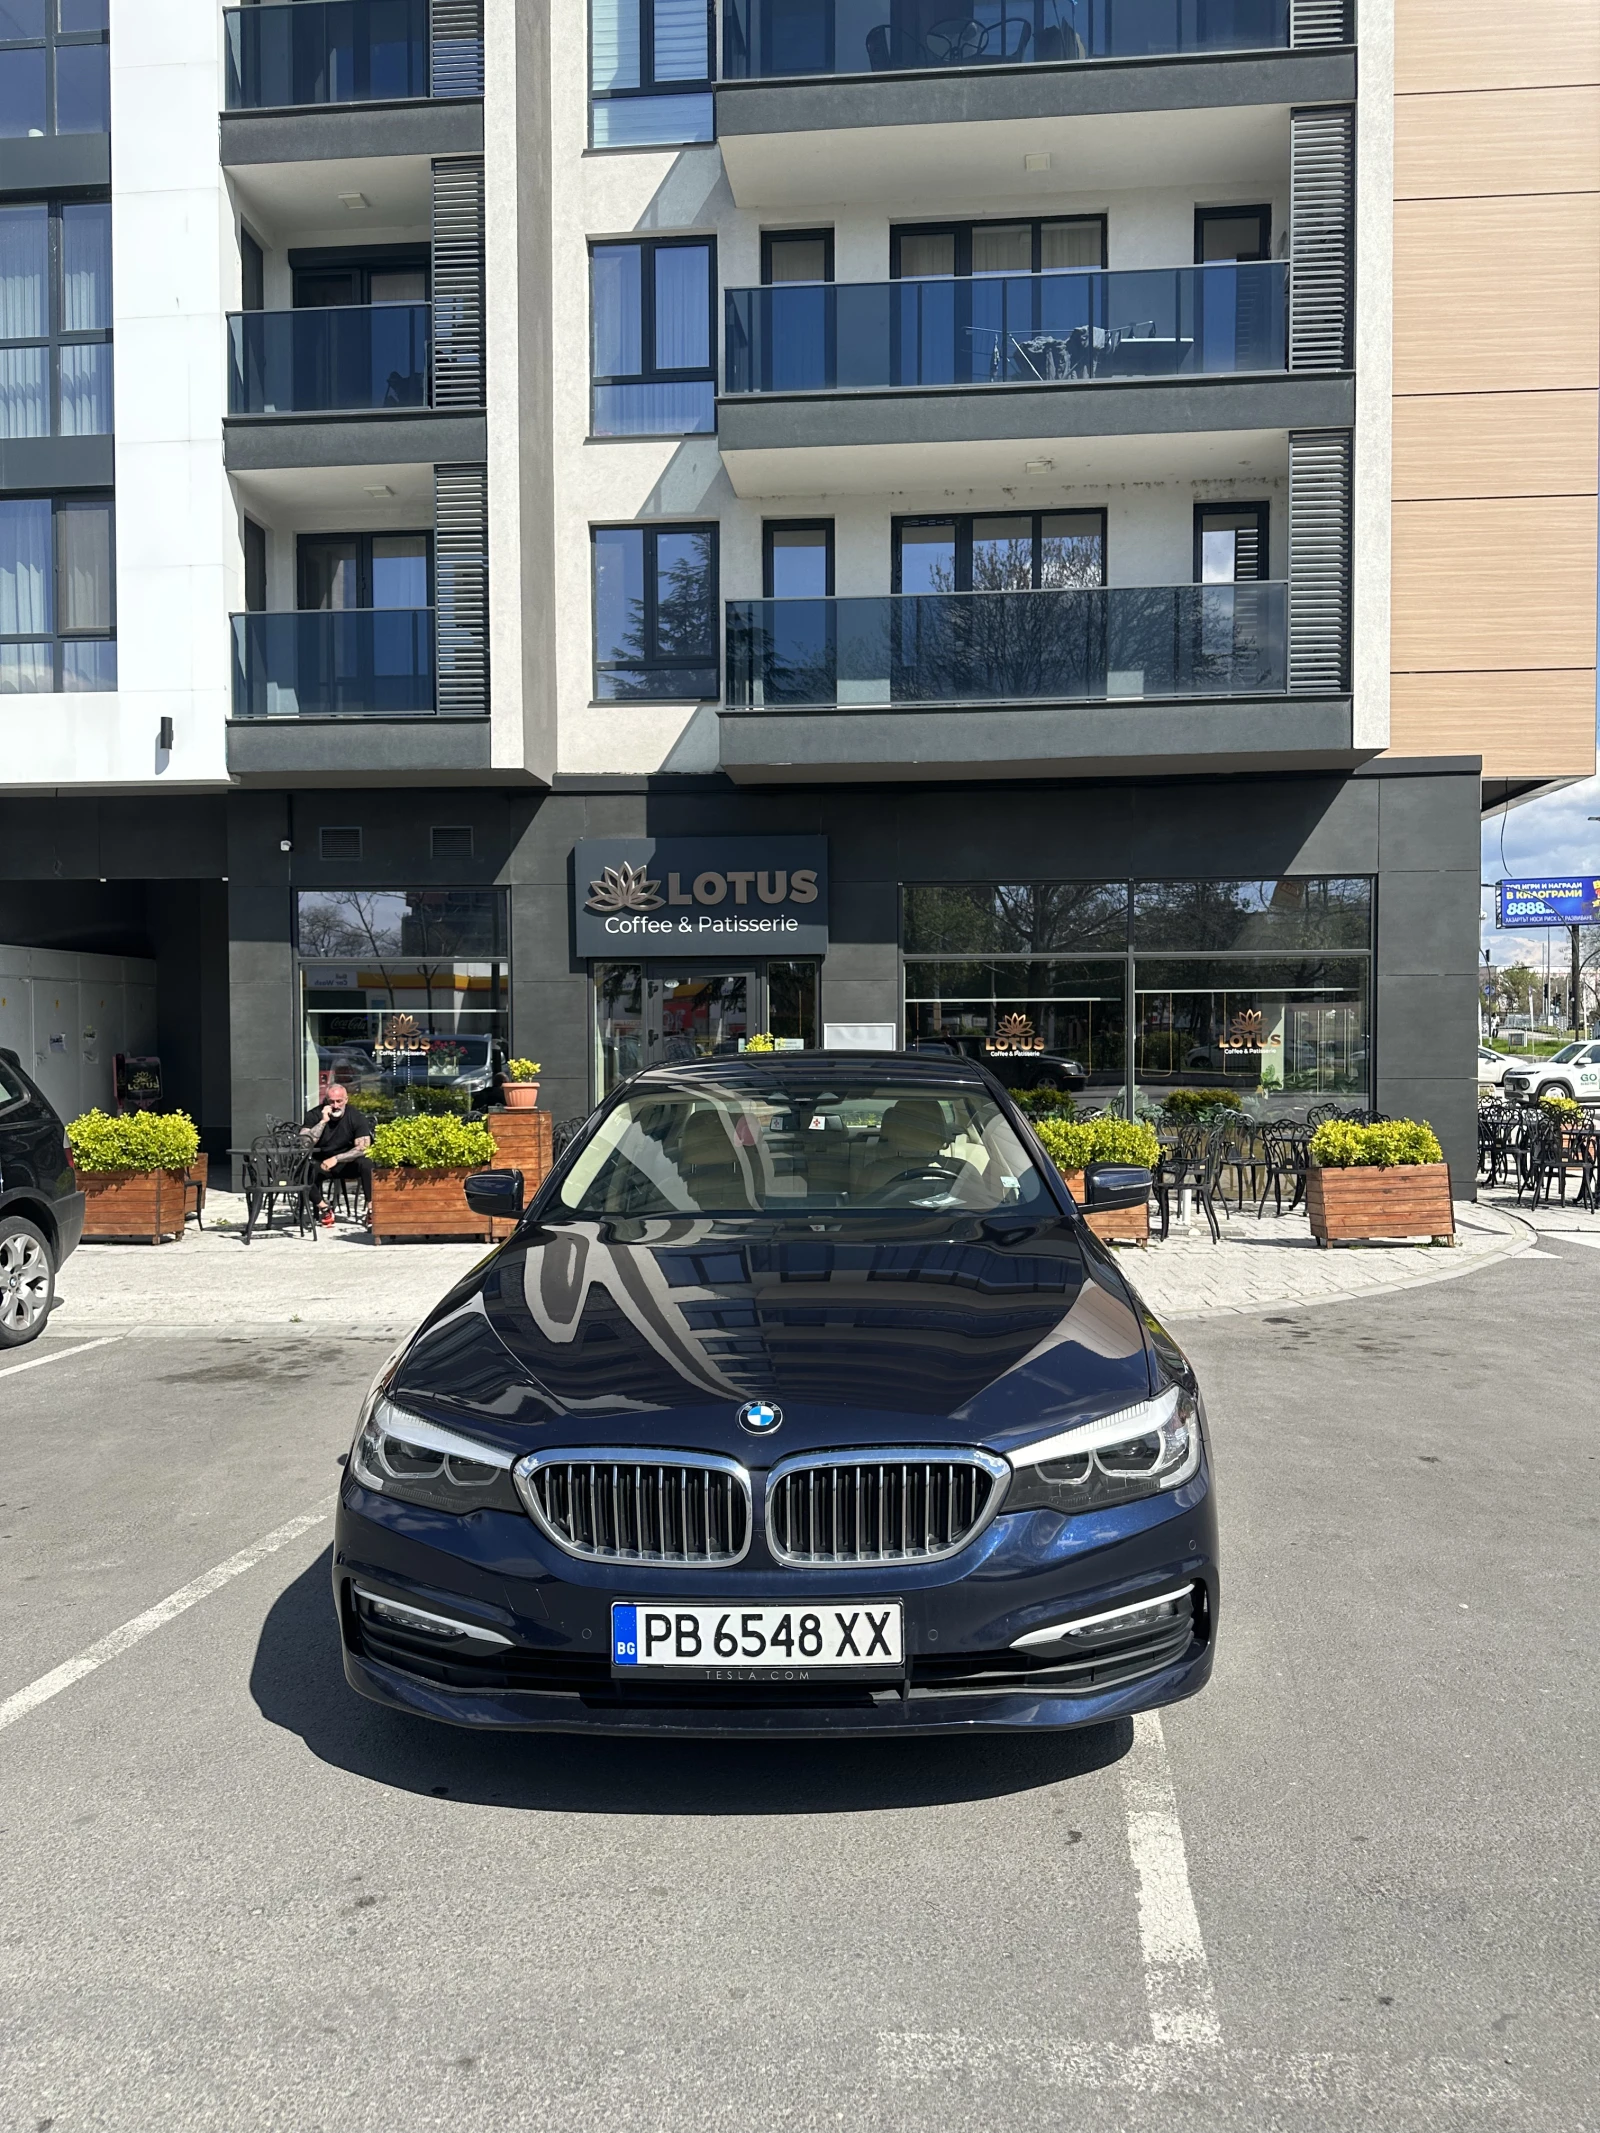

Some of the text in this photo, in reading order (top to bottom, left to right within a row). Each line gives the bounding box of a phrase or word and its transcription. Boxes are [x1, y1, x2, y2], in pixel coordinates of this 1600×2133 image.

[668, 869, 819, 905] LOTUS
[1506, 891, 1514, 899] В
[604, 914, 799, 934] Coffee & Patisserie
[375, 1037, 431, 1050] LOTUS
[986, 1037, 1044, 1050] LOTUS
[1219, 1034, 1281, 1048] LOTUS
[1580, 1073, 1597, 1082] GO
[617, 1612, 893, 1658] BG PB 6548 XX
[705, 1670, 811, 1681] TESLA.COM
